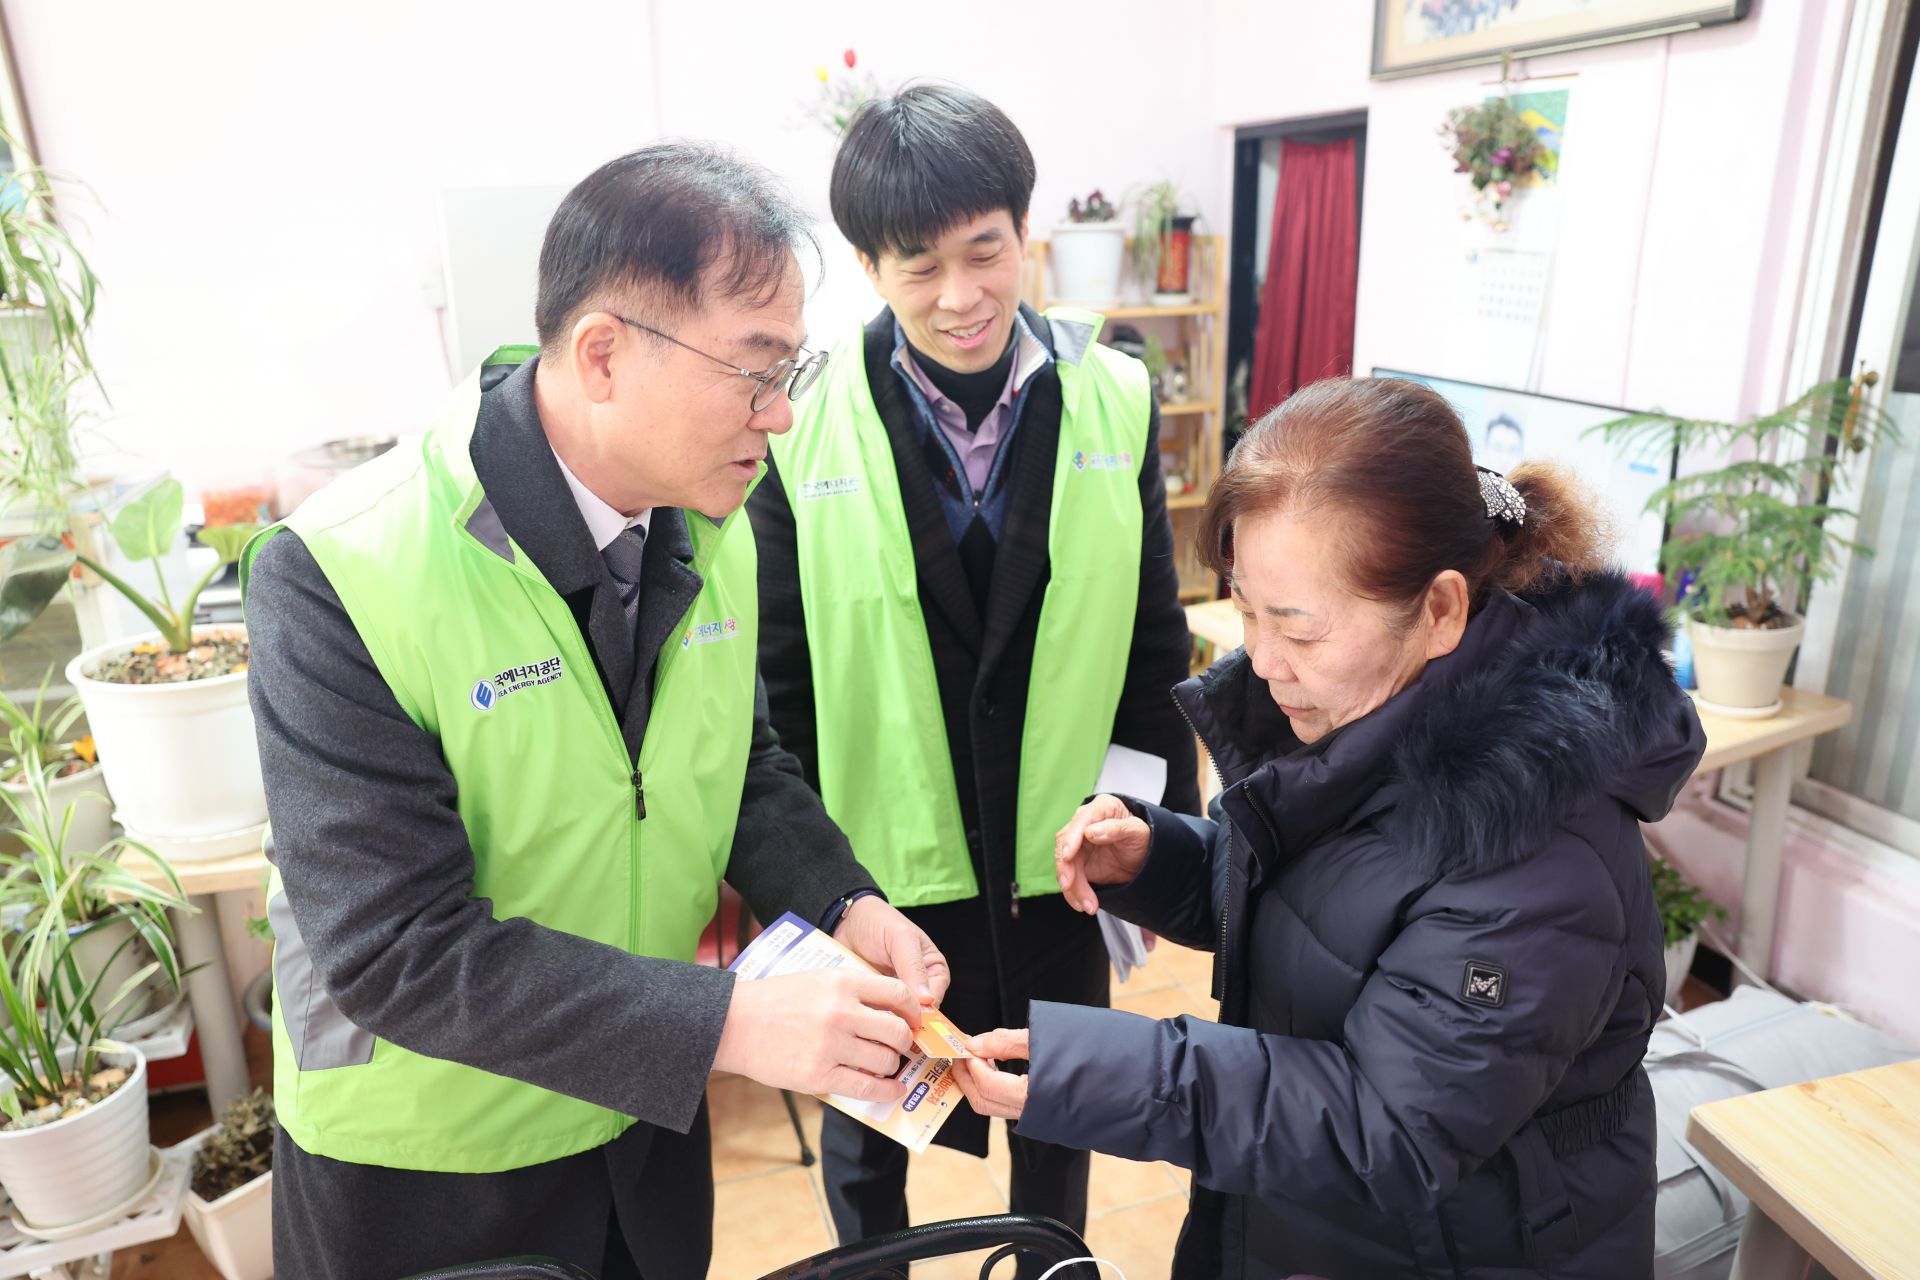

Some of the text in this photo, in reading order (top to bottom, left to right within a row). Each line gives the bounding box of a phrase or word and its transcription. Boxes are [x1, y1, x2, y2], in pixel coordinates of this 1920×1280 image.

[494, 656, 561, 687] 국에너지공단
[509, 680, 535, 693] ENERGY
[537, 671, 562, 685] AGENCY
[926, 1067, 955, 1105] 지바우처
